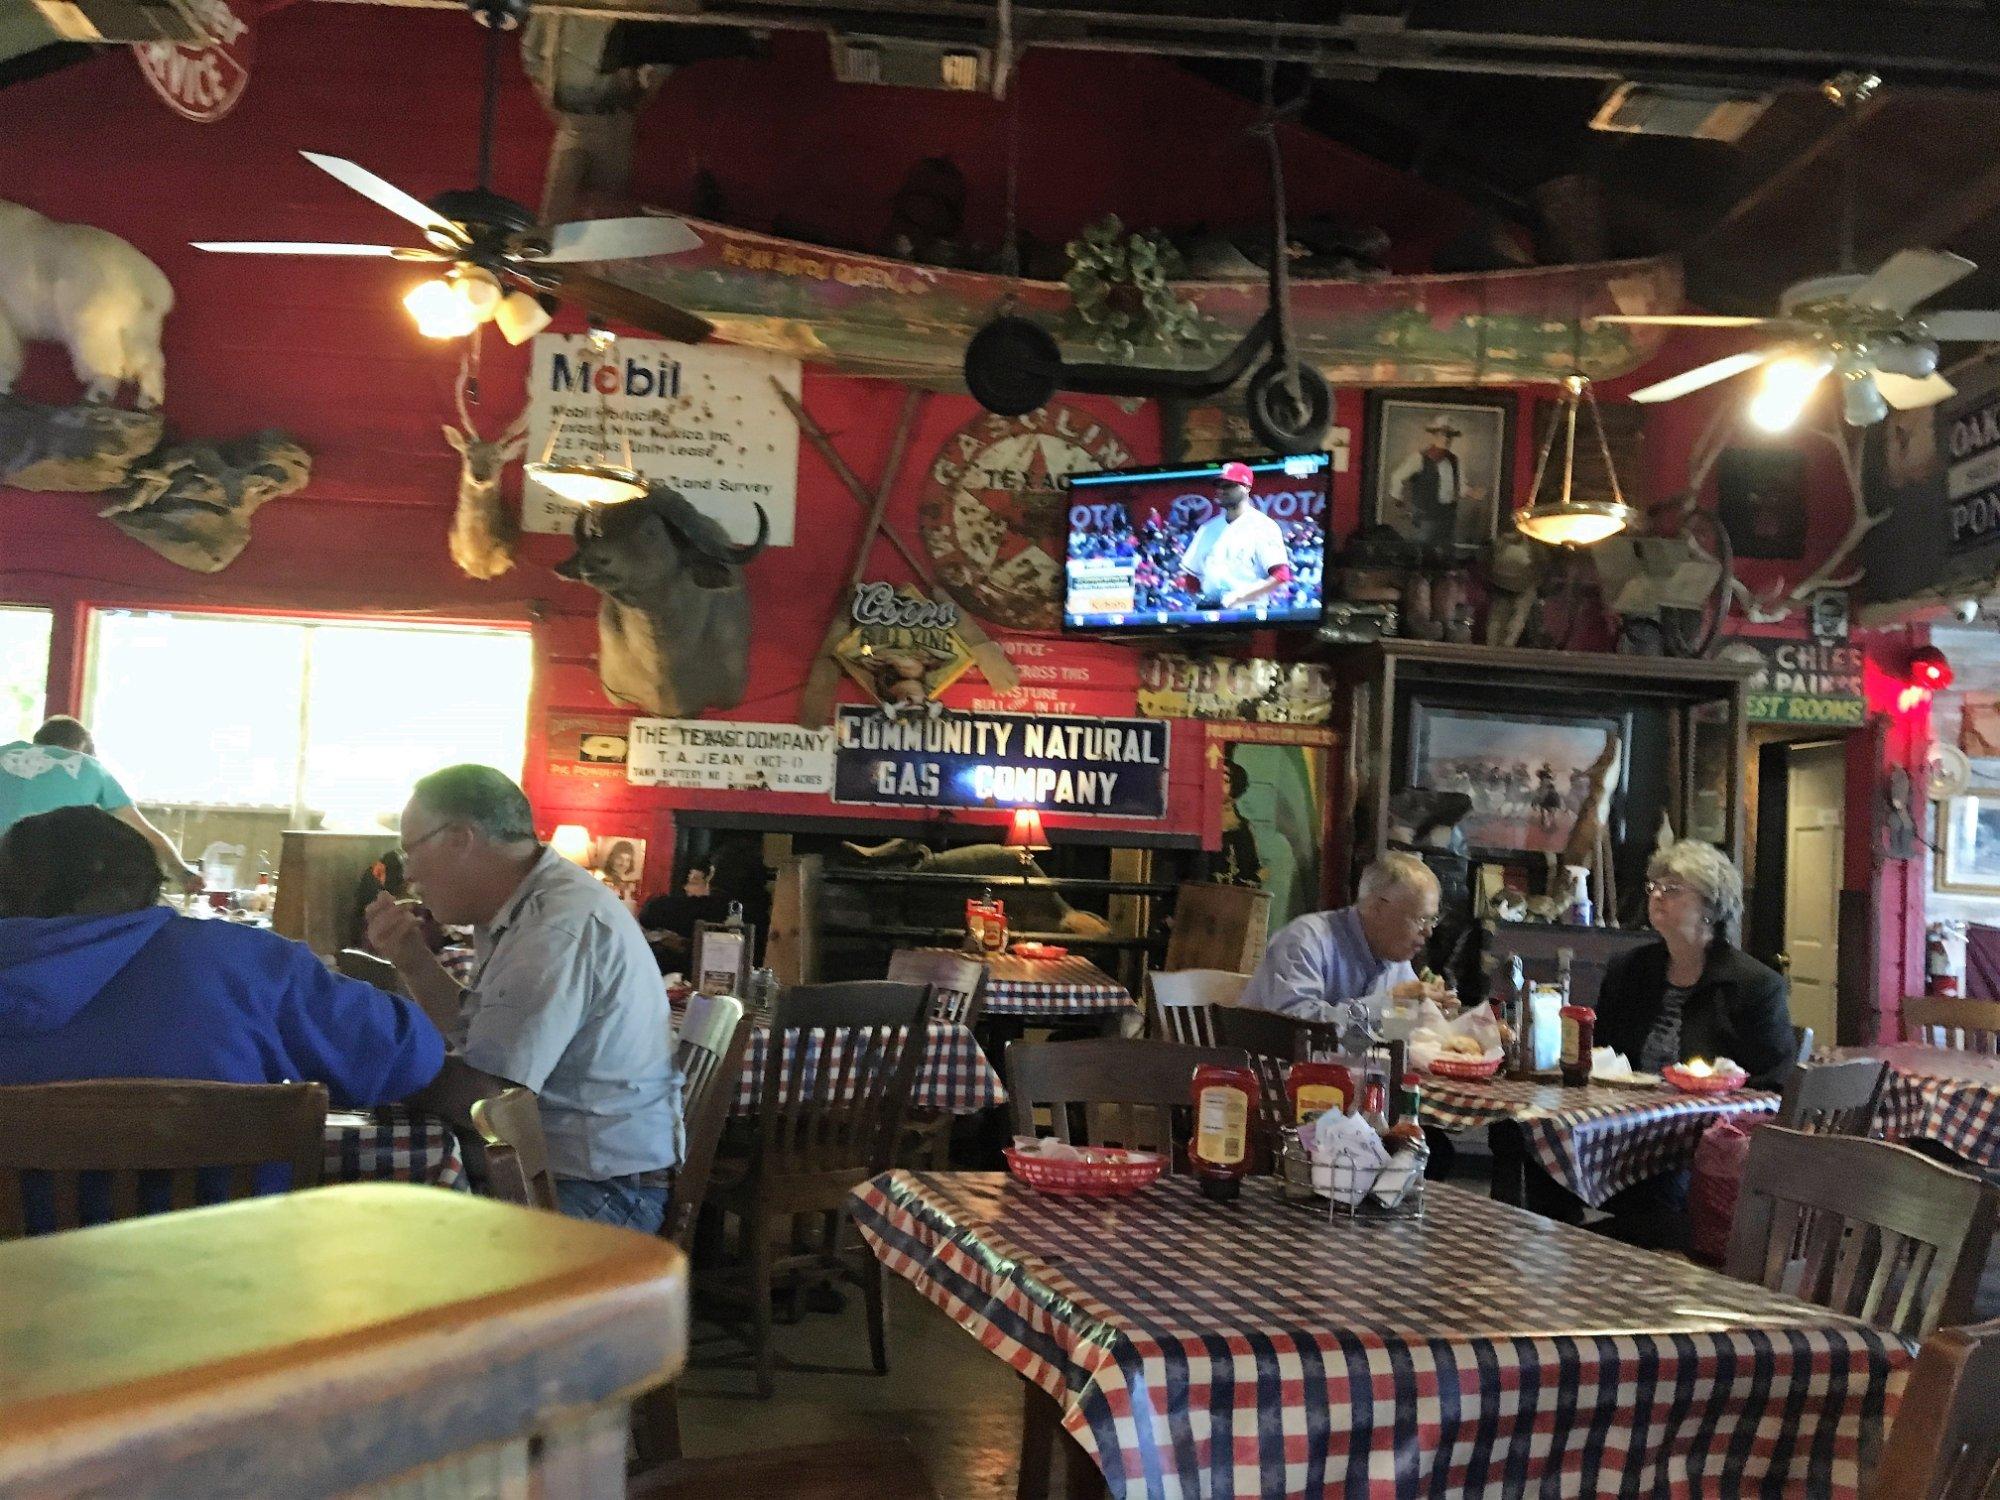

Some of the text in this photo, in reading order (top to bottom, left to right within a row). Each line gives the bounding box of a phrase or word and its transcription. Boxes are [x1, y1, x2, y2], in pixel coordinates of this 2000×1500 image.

[551, 352, 681, 398] Mobil
[552, 405, 592, 420] Mobil
[718, 478, 773, 497] Survey
[851, 581, 959, 630] Coors
[1060, 667, 1090, 682] THIS
[1033, 700, 1049, 714] IN
[1788, 697, 1863, 723] ROOMS
[635, 725, 668, 745] THE
[840, 714, 1160, 764] COMMUNITY NATURAL
[694, 752, 745, 767] JEAN
[794, 773, 823, 786] ACRES
[876, 760, 1119, 806] GAS COMPANY
